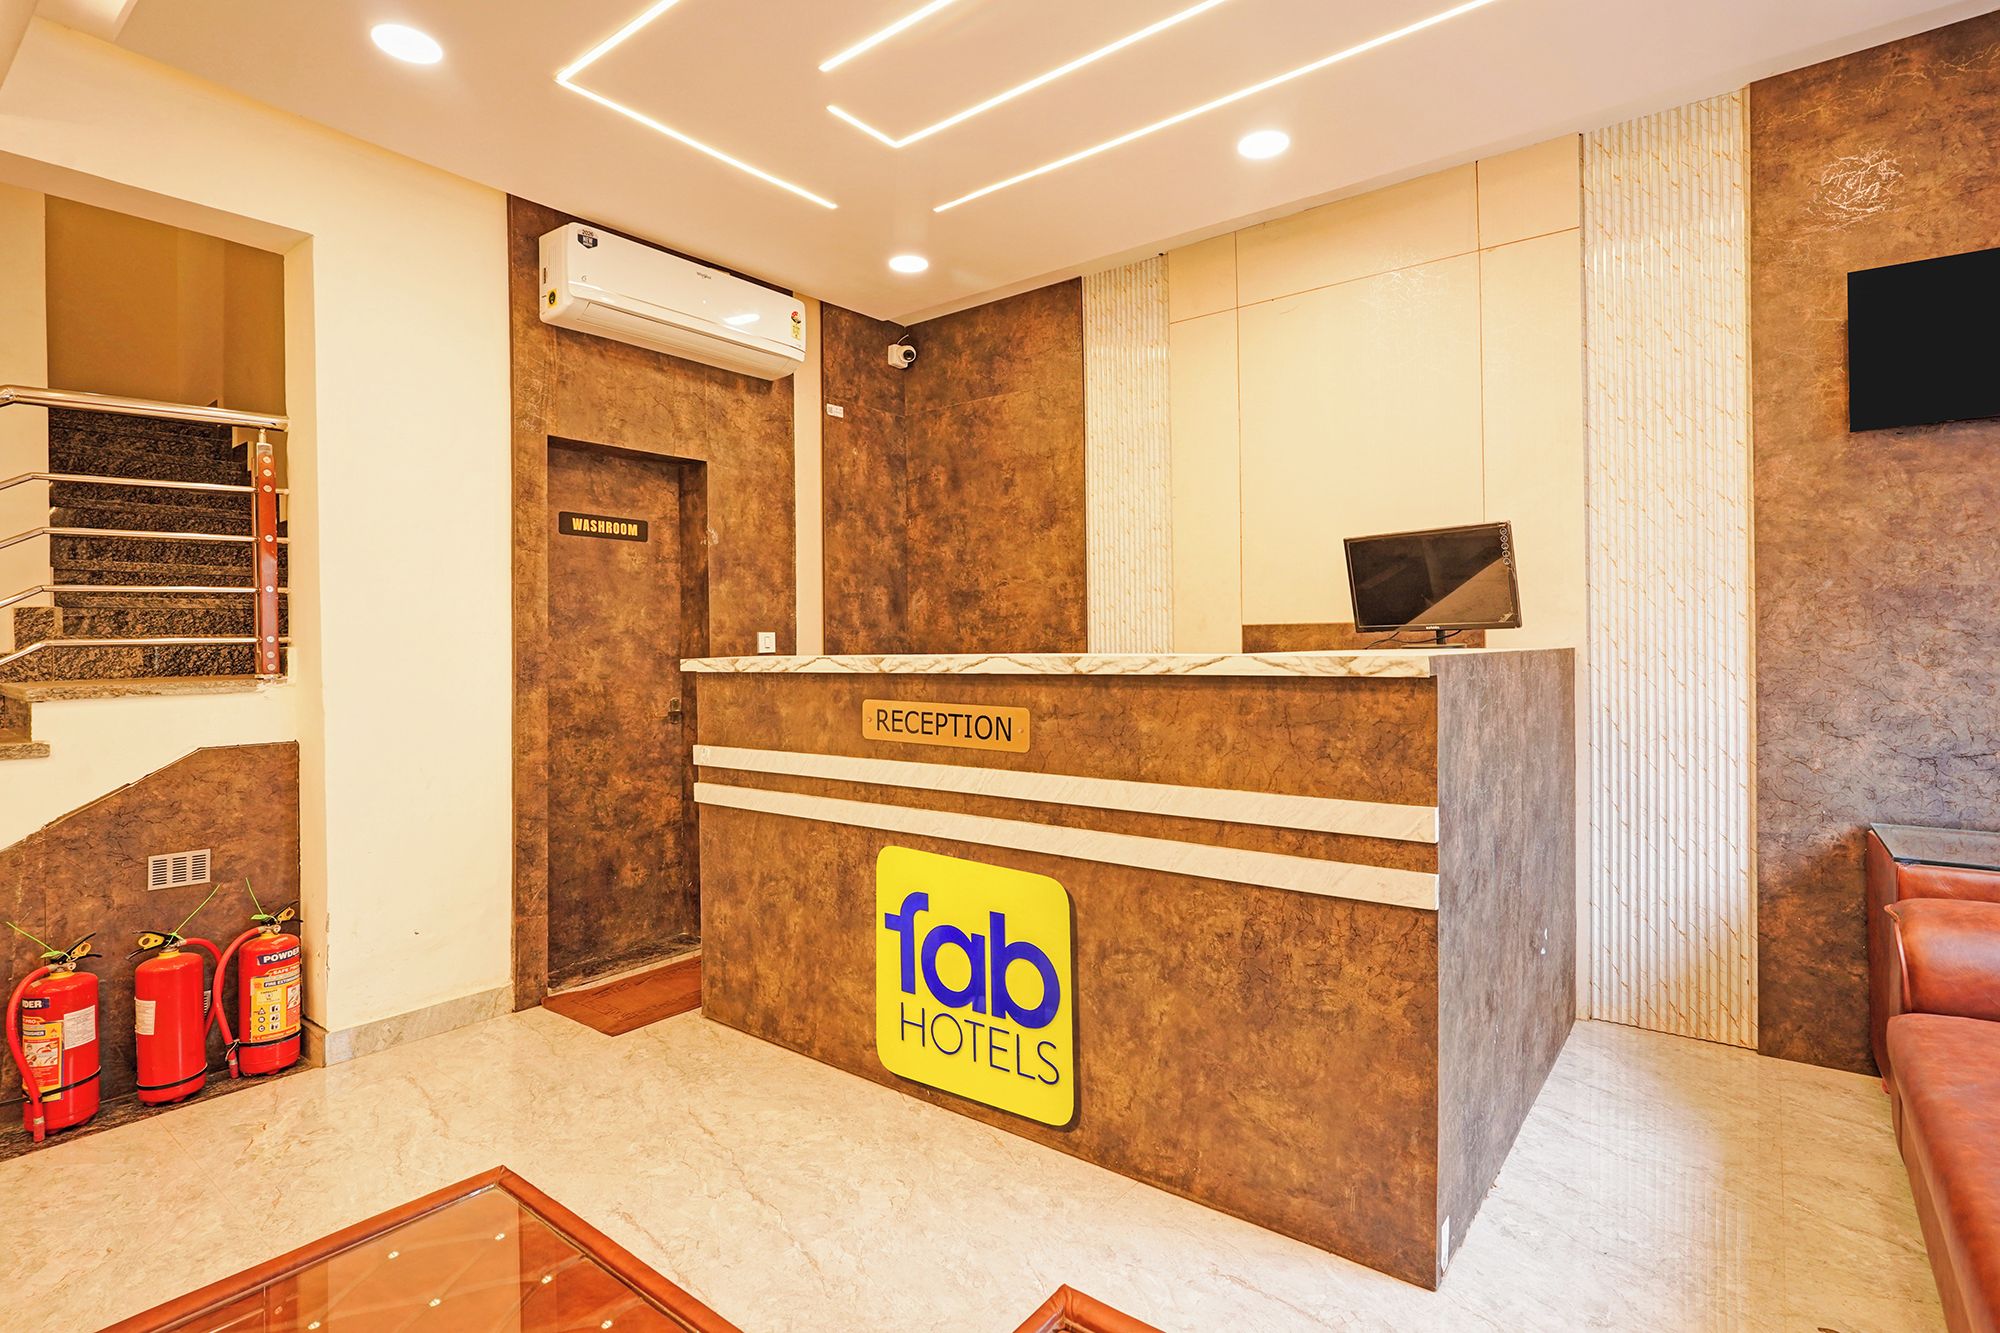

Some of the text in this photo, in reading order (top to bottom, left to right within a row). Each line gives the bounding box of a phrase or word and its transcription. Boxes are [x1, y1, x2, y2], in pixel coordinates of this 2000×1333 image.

[572, 518, 638, 536] WASHROOM
[876, 709, 1012, 742] RECEPTION
[884, 891, 1061, 1029] fab
[900, 1001, 1060, 1086] HOTELS
